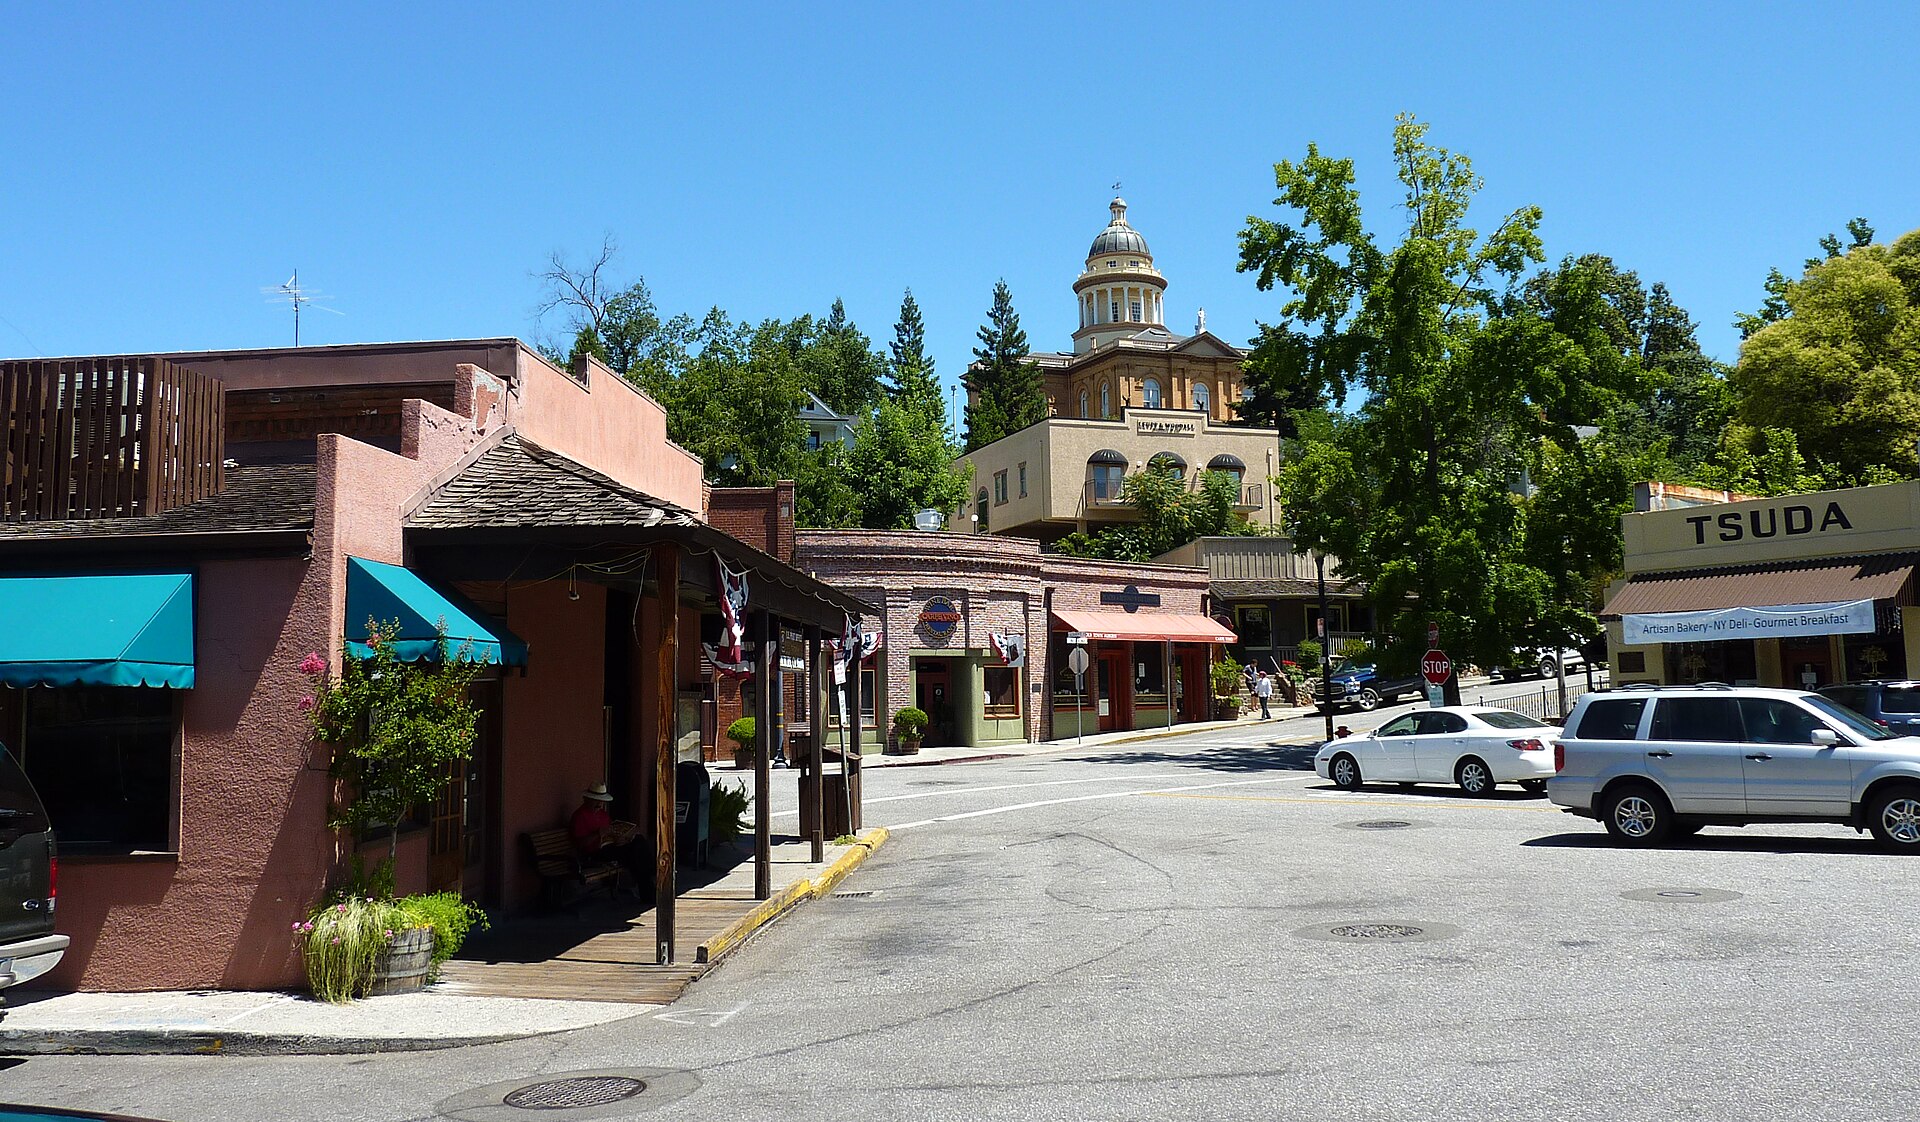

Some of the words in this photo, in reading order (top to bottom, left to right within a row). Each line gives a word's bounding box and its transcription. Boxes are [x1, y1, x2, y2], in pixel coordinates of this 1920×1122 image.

[1687, 502, 1853, 544] TSUDA
[924, 597, 941, 612] WINE
[1642, 623, 1675, 635] Artisan
[1800, 613, 1849, 627] Breakfast
[1423, 660, 1449, 674] STOP
